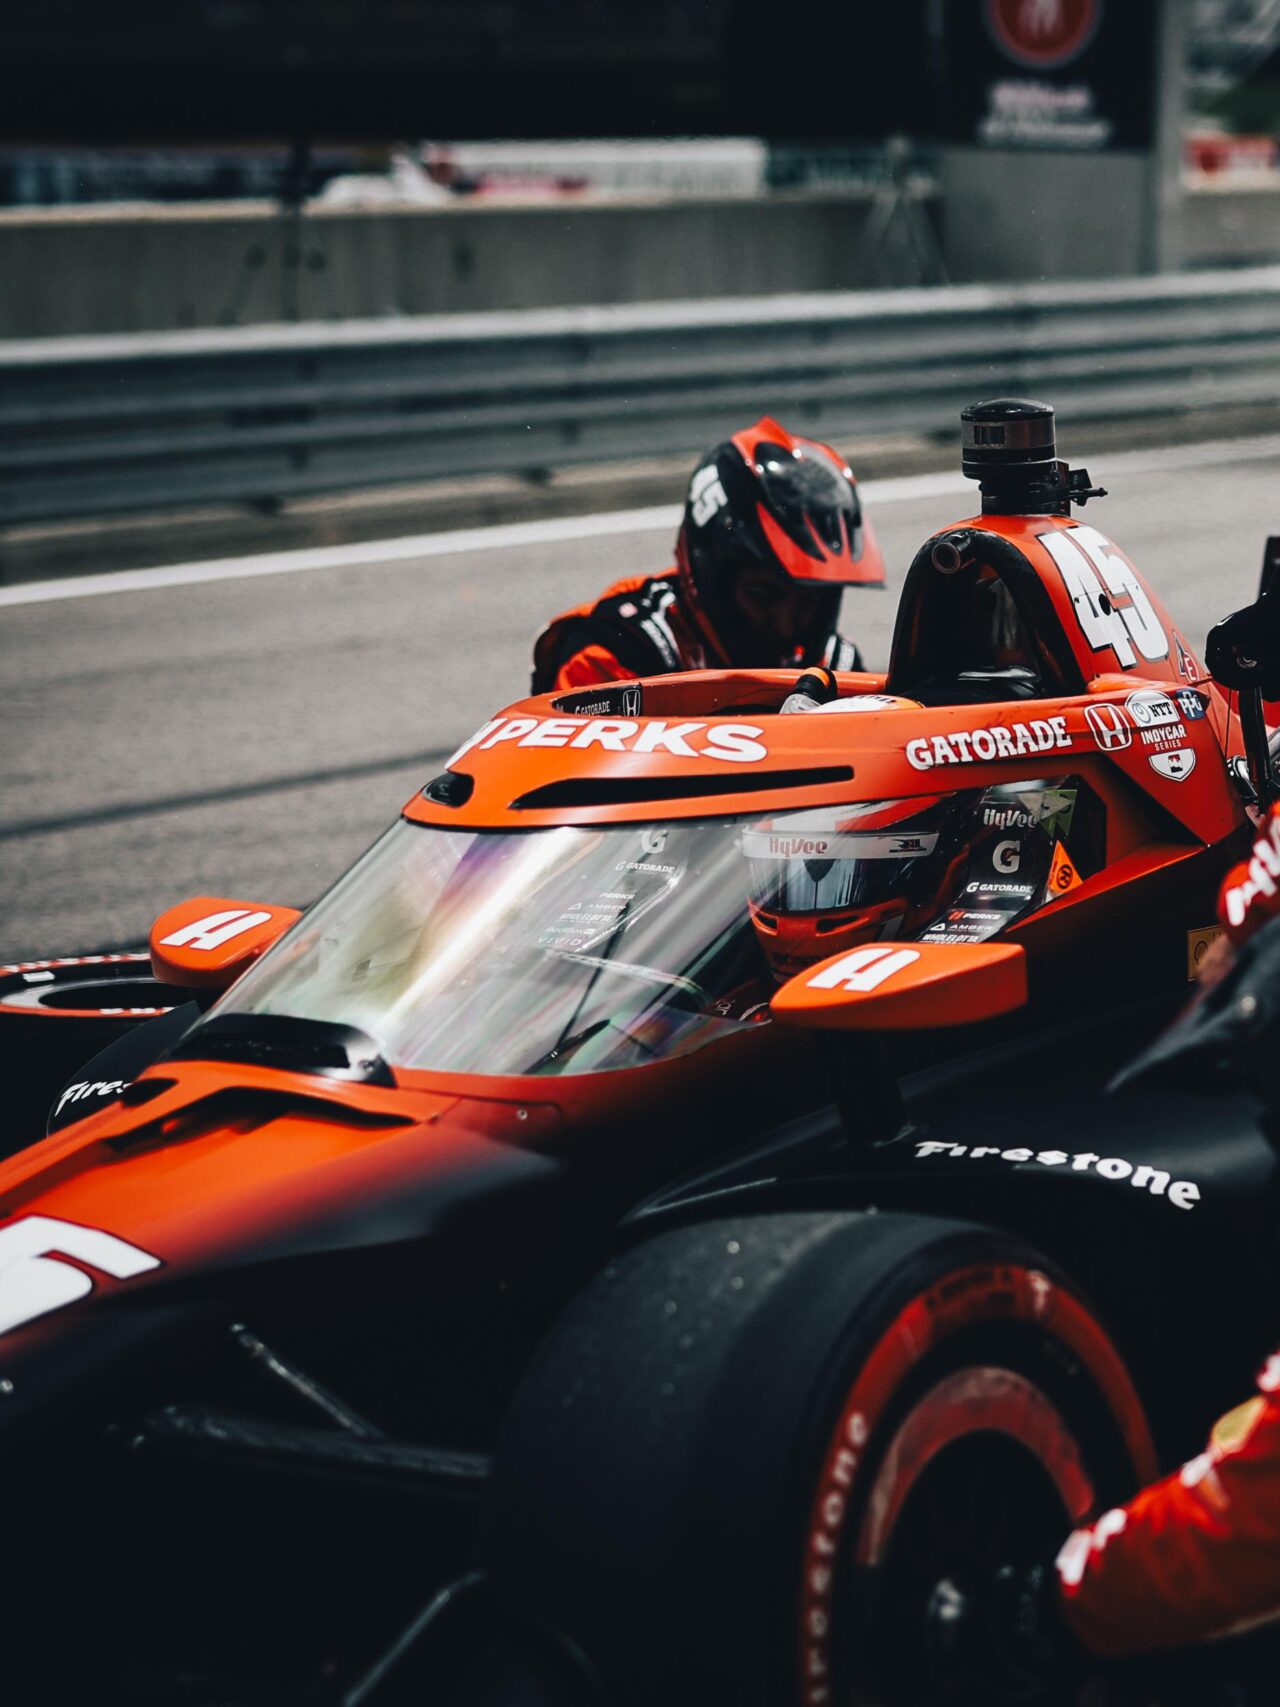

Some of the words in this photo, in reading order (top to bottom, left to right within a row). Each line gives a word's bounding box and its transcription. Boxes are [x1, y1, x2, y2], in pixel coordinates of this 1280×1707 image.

[1036, 526, 1168, 671] 45
[1148, 702, 1174, 717] NTT
[906, 717, 1072, 770] GATORADE
[1141, 724, 1187, 745] INDYCAR
[1154, 740, 1182, 751] SERIES
[769, 838, 828, 857] HyVee
[992, 840, 1020, 874] G
[626, 862, 676, 873] GATORADE
[979, 883, 1034, 894] GATORADE
[962, 912, 1002, 920] PERKS
[914, 1140, 1201, 1210] Firestone
